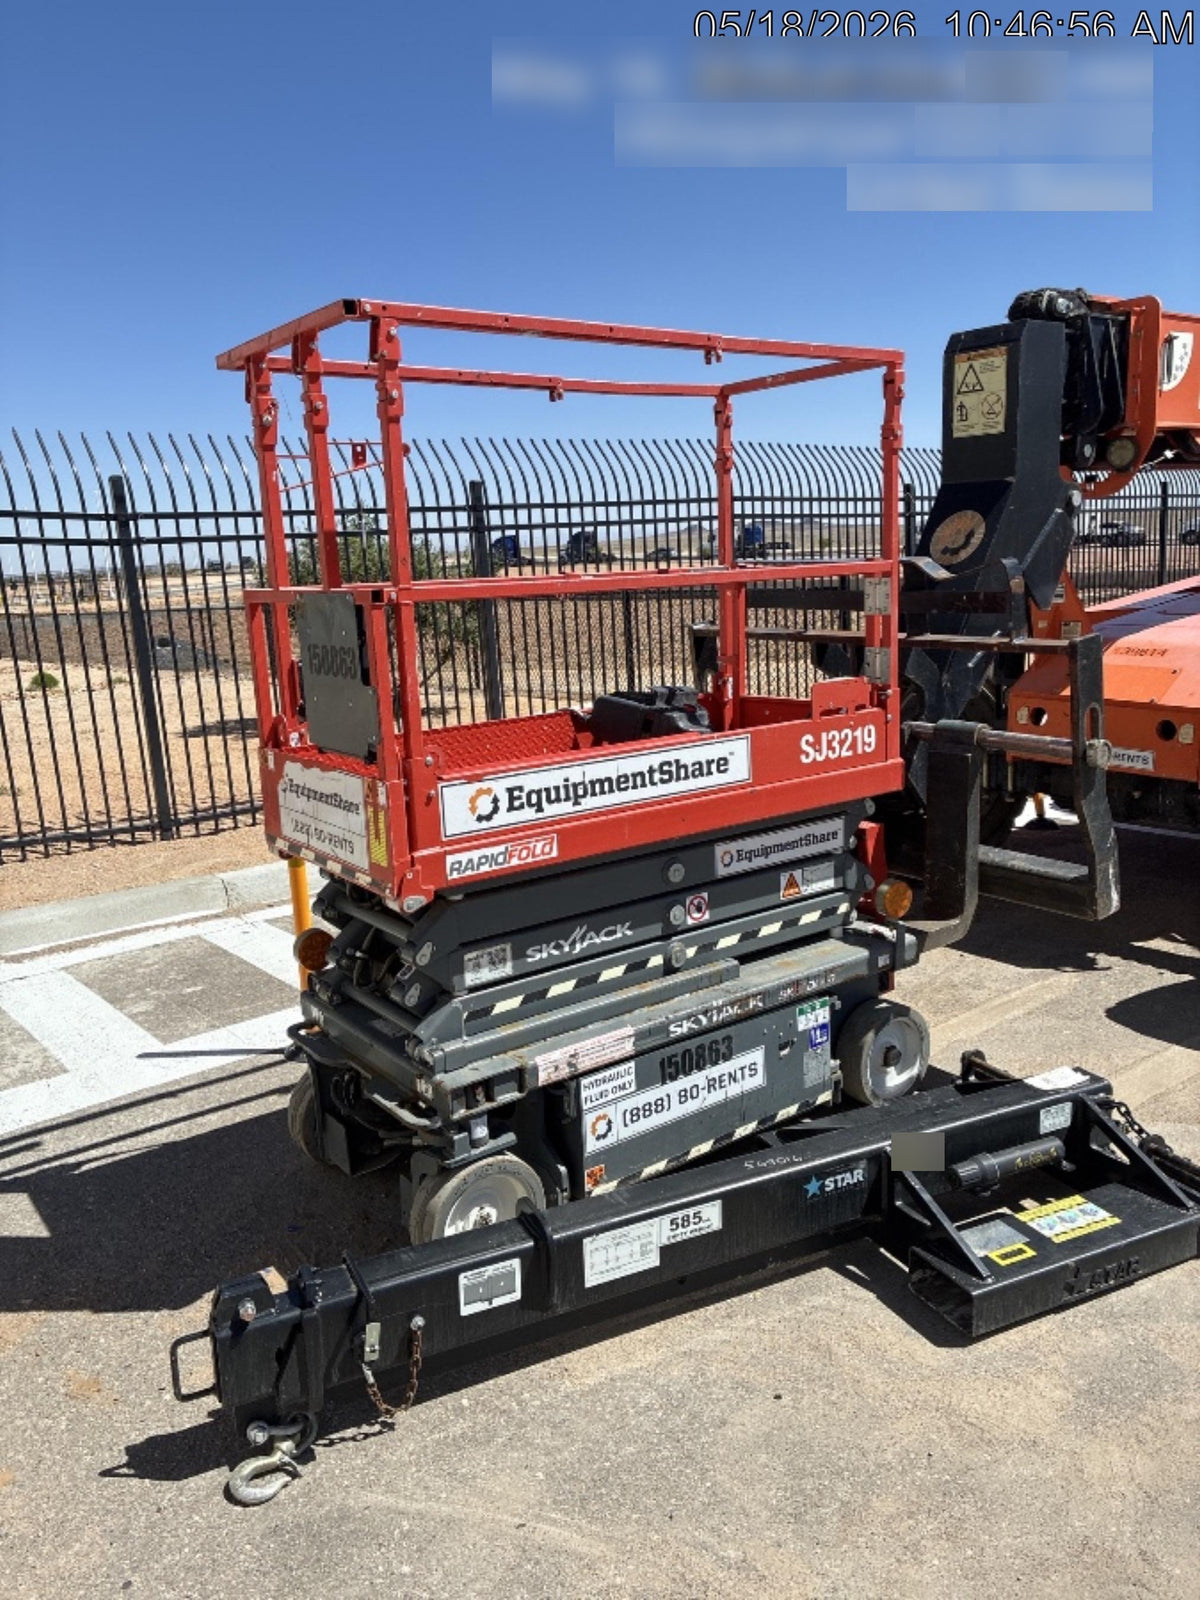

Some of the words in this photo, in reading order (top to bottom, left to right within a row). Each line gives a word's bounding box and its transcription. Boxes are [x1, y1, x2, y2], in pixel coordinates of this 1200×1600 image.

[799, 723, 877, 765] SJ3219
[504, 753, 731, 814] EquipmentShare
[735, 829, 839, 863] EquipmentShare
[525, 920, 634, 963] SKYJACK
[658, 1034, 734, 1087] 150863
[622, 1092, 672, 1129] (888)
[677, 1060, 760, 1106] 80-RENTS
[823, 1167, 865, 1193] STAR
[668, 1208, 704, 1233] 585
